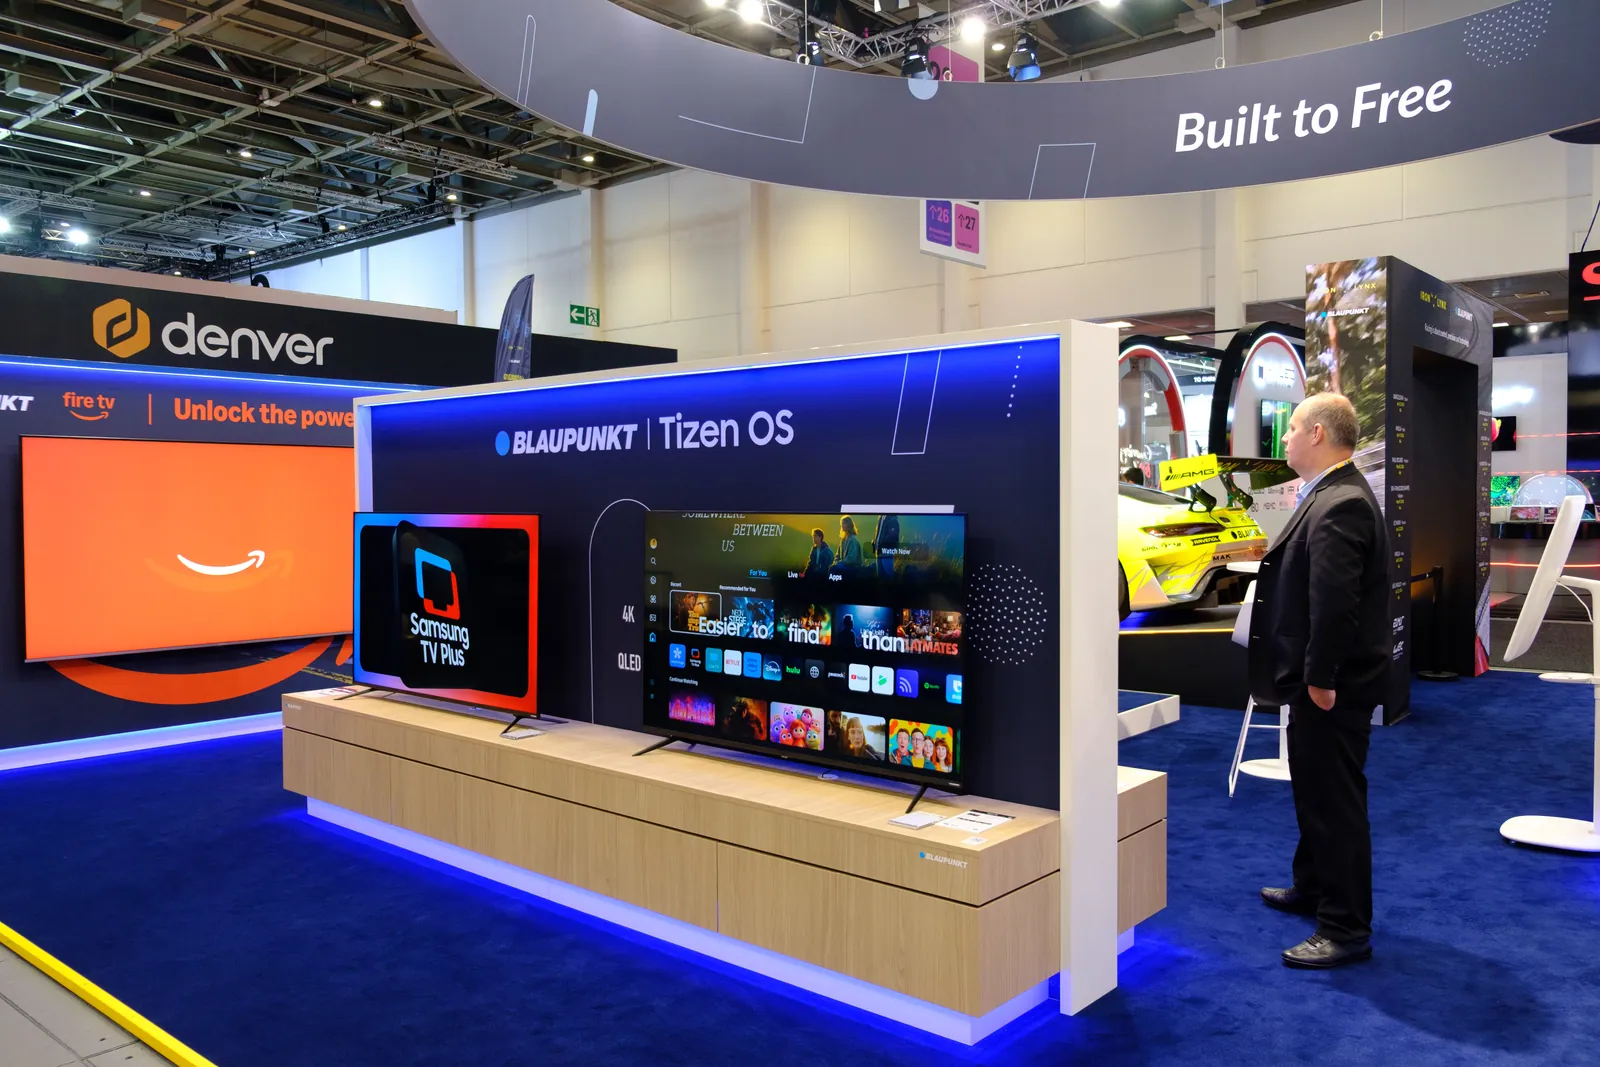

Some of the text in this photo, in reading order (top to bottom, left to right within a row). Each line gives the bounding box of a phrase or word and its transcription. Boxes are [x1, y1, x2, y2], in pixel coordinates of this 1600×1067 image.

[1175, 79, 1453, 152] Built to Free
[937, 207, 950, 224] 26
[965, 215, 976, 231] 27
[1327, 307, 1369, 317] BLAUPUNKT
[161, 312, 334, 366] denver
[62, 391, 115, 409] fire tv
[174, 398, 354, 429] Unlock the powe
[512, 409, 794, 455] BLAUPUNKT Tizen OS
[1180, 468, 1215, 478] AMG
[732, 523, 784, 537] BETWEEN
[721, 540, 735, 552] US
[881, 547, 898, 555] Watch
[829, 573, 842, 581] Apps
[622, 605, 635, 623] 4K
[410, 612, 470, 650] Samsung
[699, 616, 743, 636] Easier
[752, 621, 769, 639] to
[788, 622, 820, 644] find
[861, 631, 905, 653] than
[420, 640, 465, 667] TV Plus
[904, 638, 959, 655] LATMATES
[618, 652, 642, 672] QLED
[786, 665, 801, 674] hulu
[925, 852, 968, 869] BLAUPUNKT
